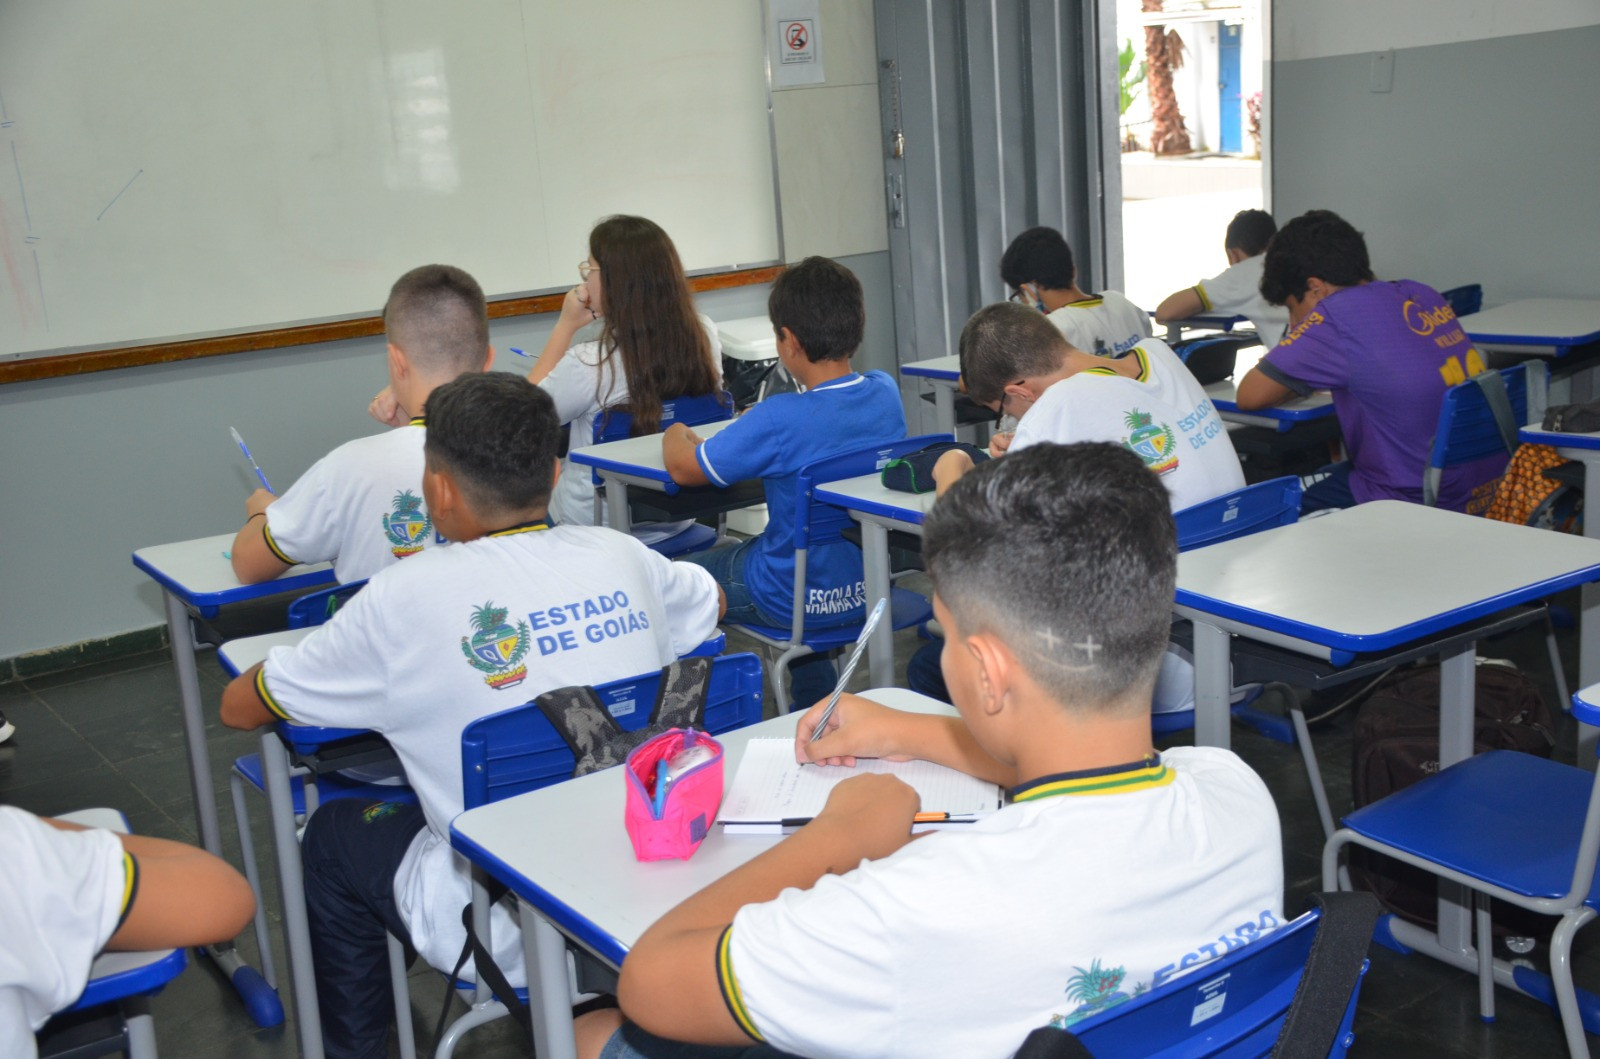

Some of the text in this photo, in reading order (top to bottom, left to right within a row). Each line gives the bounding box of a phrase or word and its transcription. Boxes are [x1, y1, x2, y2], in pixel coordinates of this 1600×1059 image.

[1176, 399, 1212, 432] ESTADO
[1189, 433, 1207, 450] DE
[528, 590, 629, 631] ESTADO
[536, 609, 649, 656] DE GOIÁS
